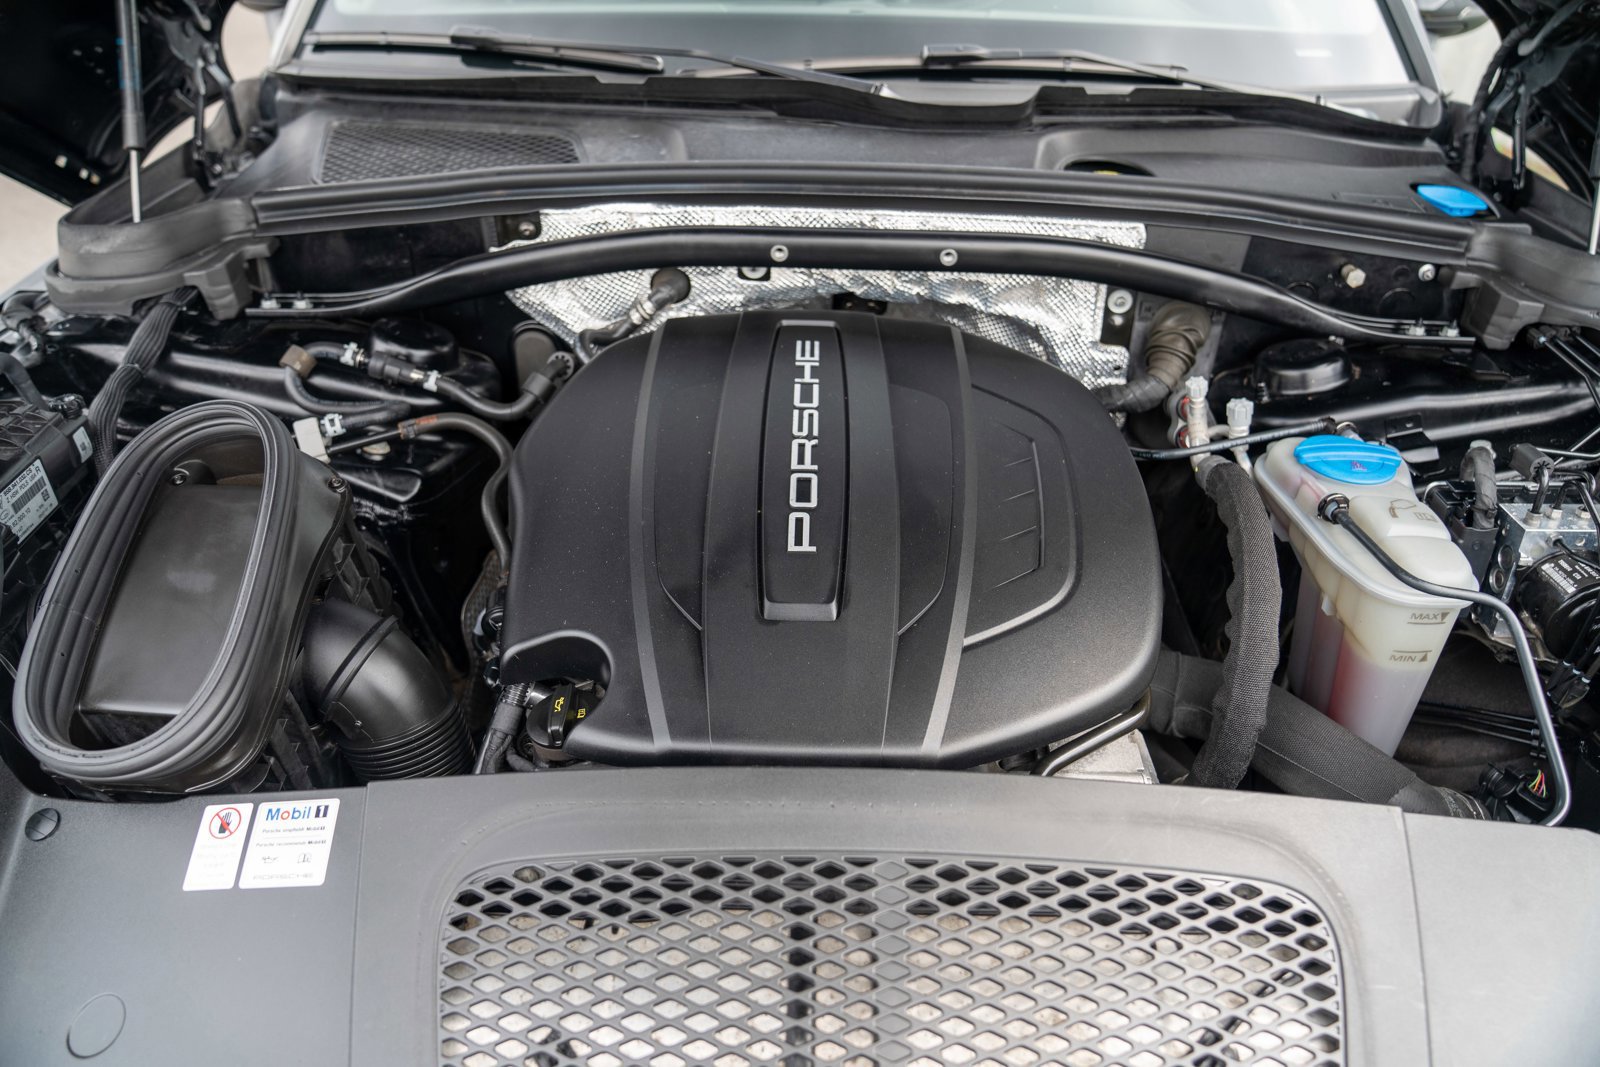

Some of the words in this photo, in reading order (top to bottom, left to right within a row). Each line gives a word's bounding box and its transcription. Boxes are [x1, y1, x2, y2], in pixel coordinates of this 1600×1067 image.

[787, 340, 820, 552] PORSCHE
[1410, 612, 1440, 620] MAX
[1389, 654, 1417, 662] MIN
[266, 806, 311, 821] Mobil
[315, 805, 329, 818] 1
